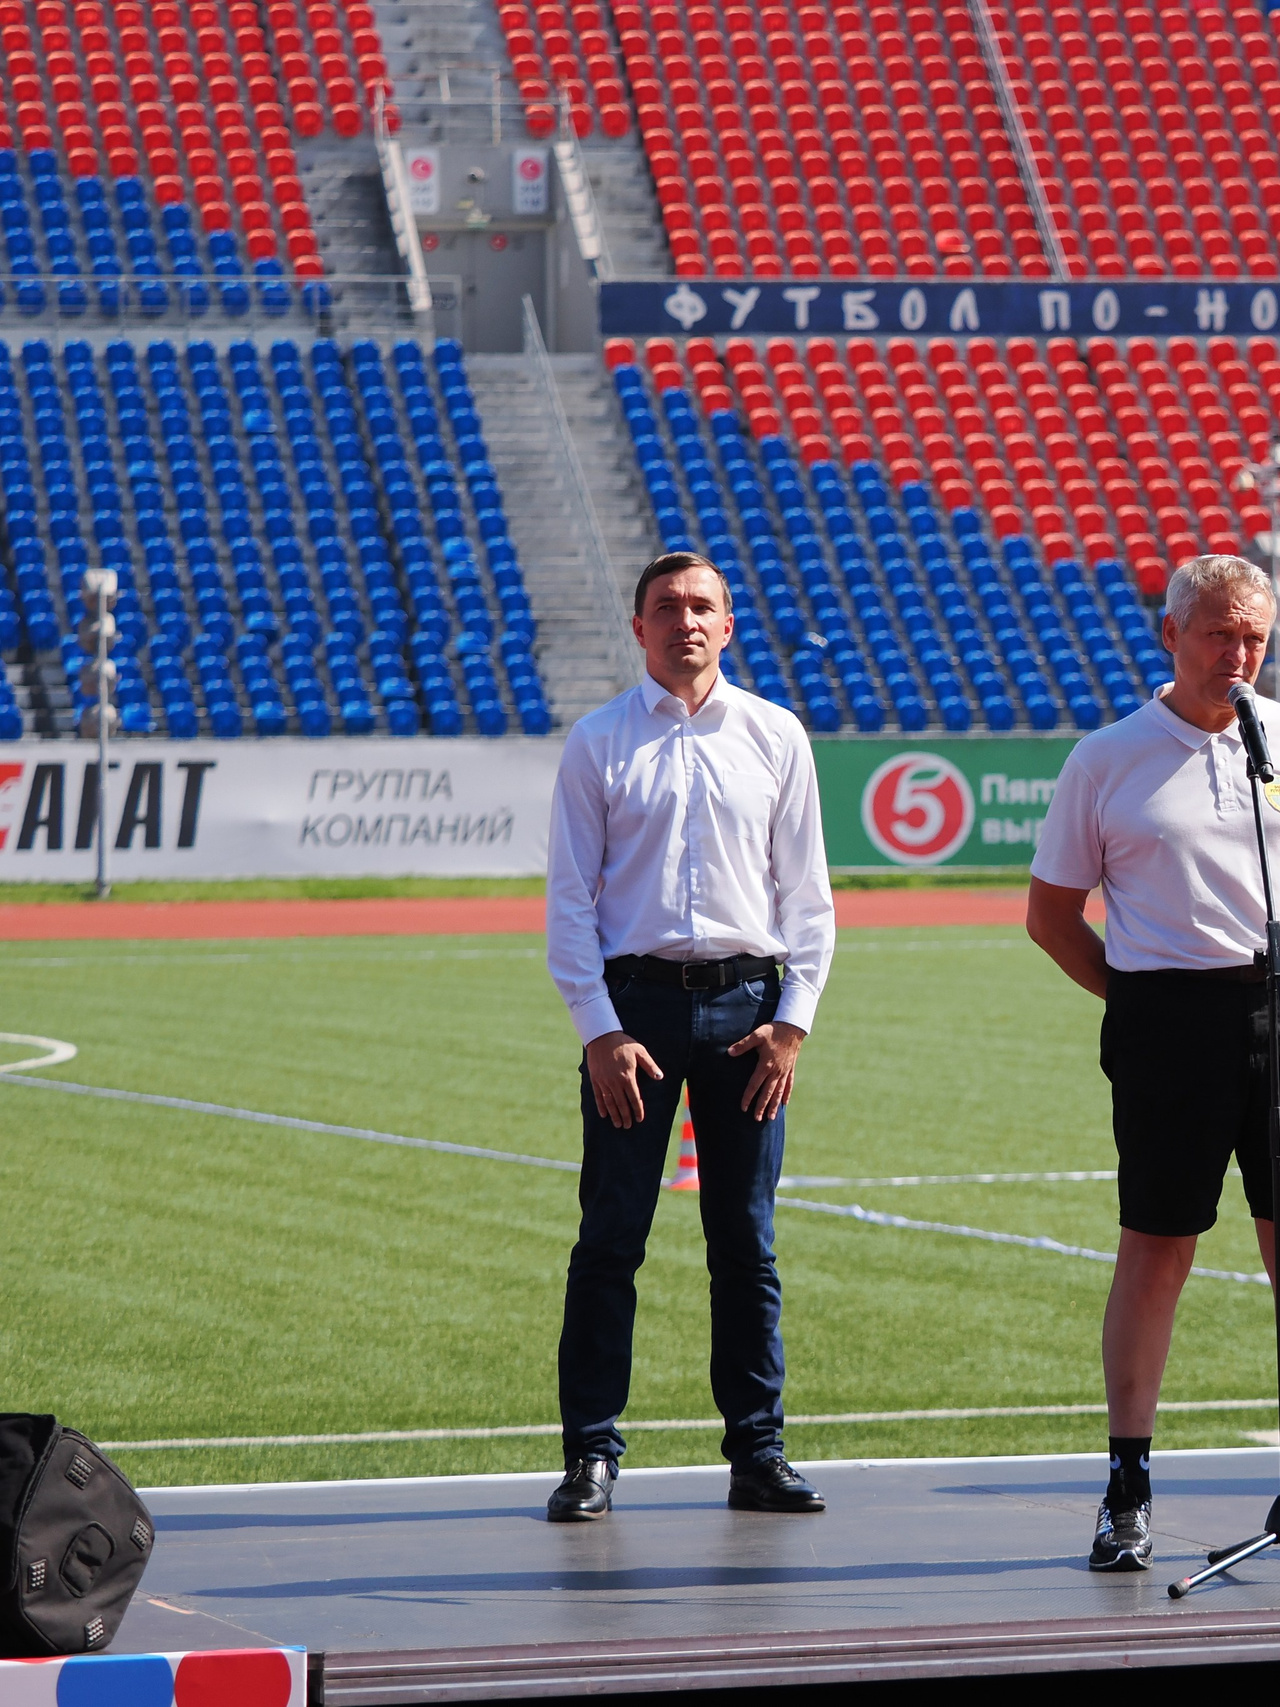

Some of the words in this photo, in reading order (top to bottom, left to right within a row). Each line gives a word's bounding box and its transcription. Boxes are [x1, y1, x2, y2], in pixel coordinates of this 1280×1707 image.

[664, 283, 981, 332] ФУТБОЛ
[16, 761, 217, 851] АГАТ
[307, 768, 453, 801] ГРУППА
[299, 805, 515, 847] КОМПАНИЙ
